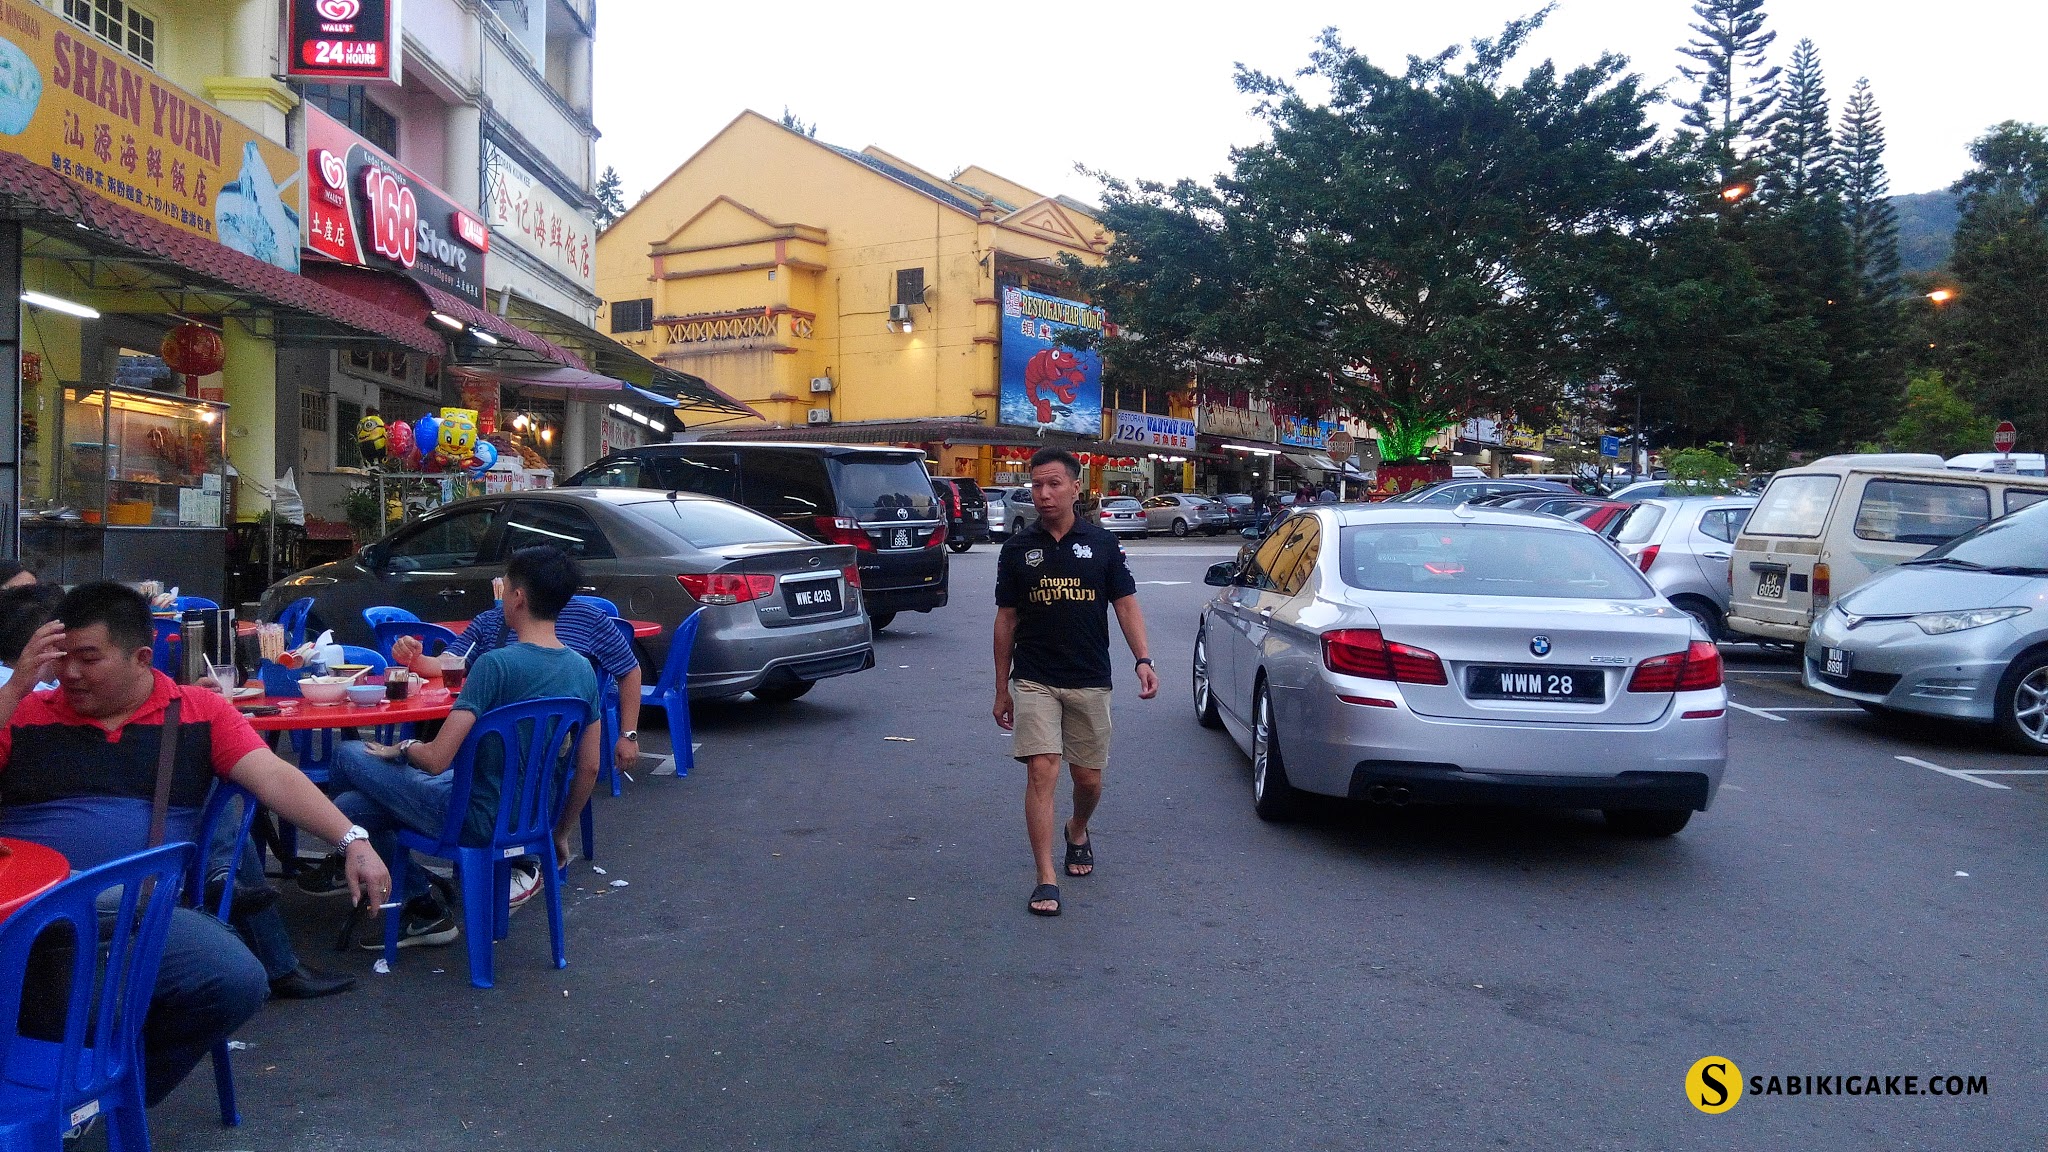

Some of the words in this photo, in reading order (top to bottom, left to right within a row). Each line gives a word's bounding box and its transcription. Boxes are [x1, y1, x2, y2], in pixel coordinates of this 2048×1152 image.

[315, 41, 345, 63] 24
[346, 43, 376, 54] JAM
[346, 53, 376, 65] HOURS
[53, 29, 143, 127] SHAN
[148, 82, 223, 168] YUAN
[366, 167, 418, 269] 168
[417, 219, 467, 273] Store
[463, 217, 475, 241] 24
[1021, 294, 1063, 323] RESTORAN
[1064, 304, 1079, 326] HAR
[1080, 308, 1102, 331] WONG
[1118, 412, 1144, 424] RESTORAN
[1117, 424, 1145, 442] 126
[896, 529, 906, 538] JSC
[795, 591, 814, 606] WWE
[813, 589, 832, 603] 4219
[1759, 584, 1781, 598] 8029
[1826, 661, 1843, 674] 8891
[1501, 673, 1542, 693] WWM
[1547, 675, 1573, 695] 28
